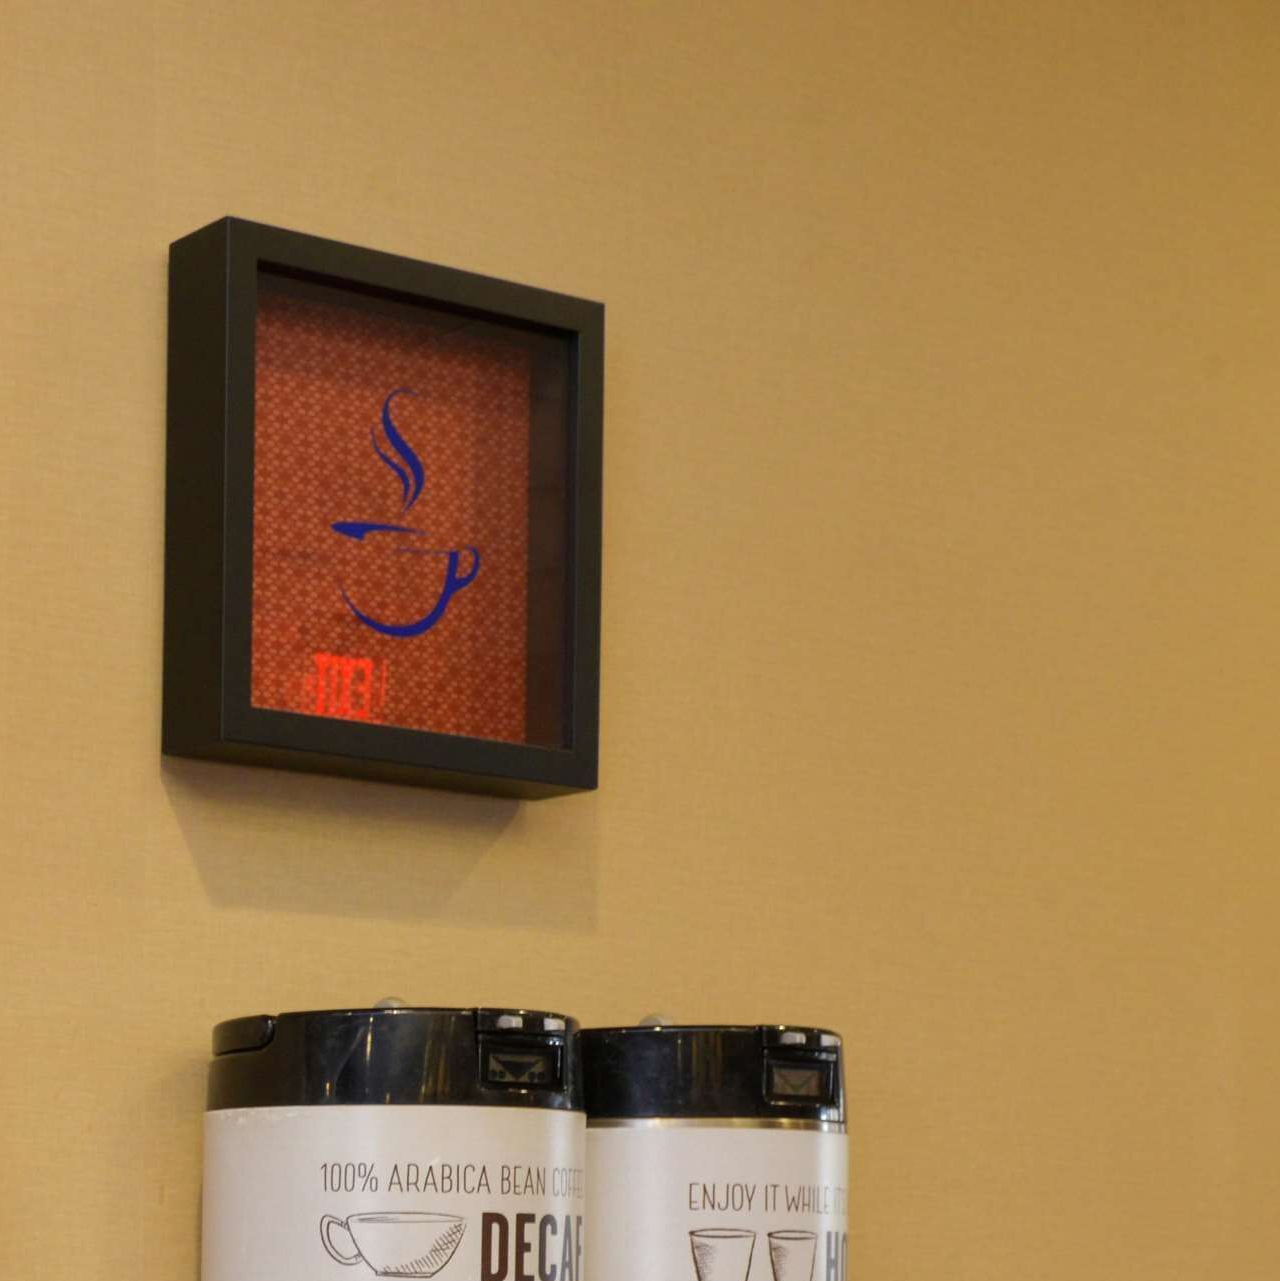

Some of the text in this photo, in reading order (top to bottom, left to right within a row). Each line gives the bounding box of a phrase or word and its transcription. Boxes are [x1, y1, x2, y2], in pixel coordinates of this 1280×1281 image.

[320, 1162, 379, 1194] 100%
[387, 1163, 491, 1195] ARABICA
[500, 1165, 546, 1197] BEAN
[688, 1183, 757, 1212] ENJOY
[764, 1184, 781, 1213] IT
[784, 1184, 830, 1215] WHILE
